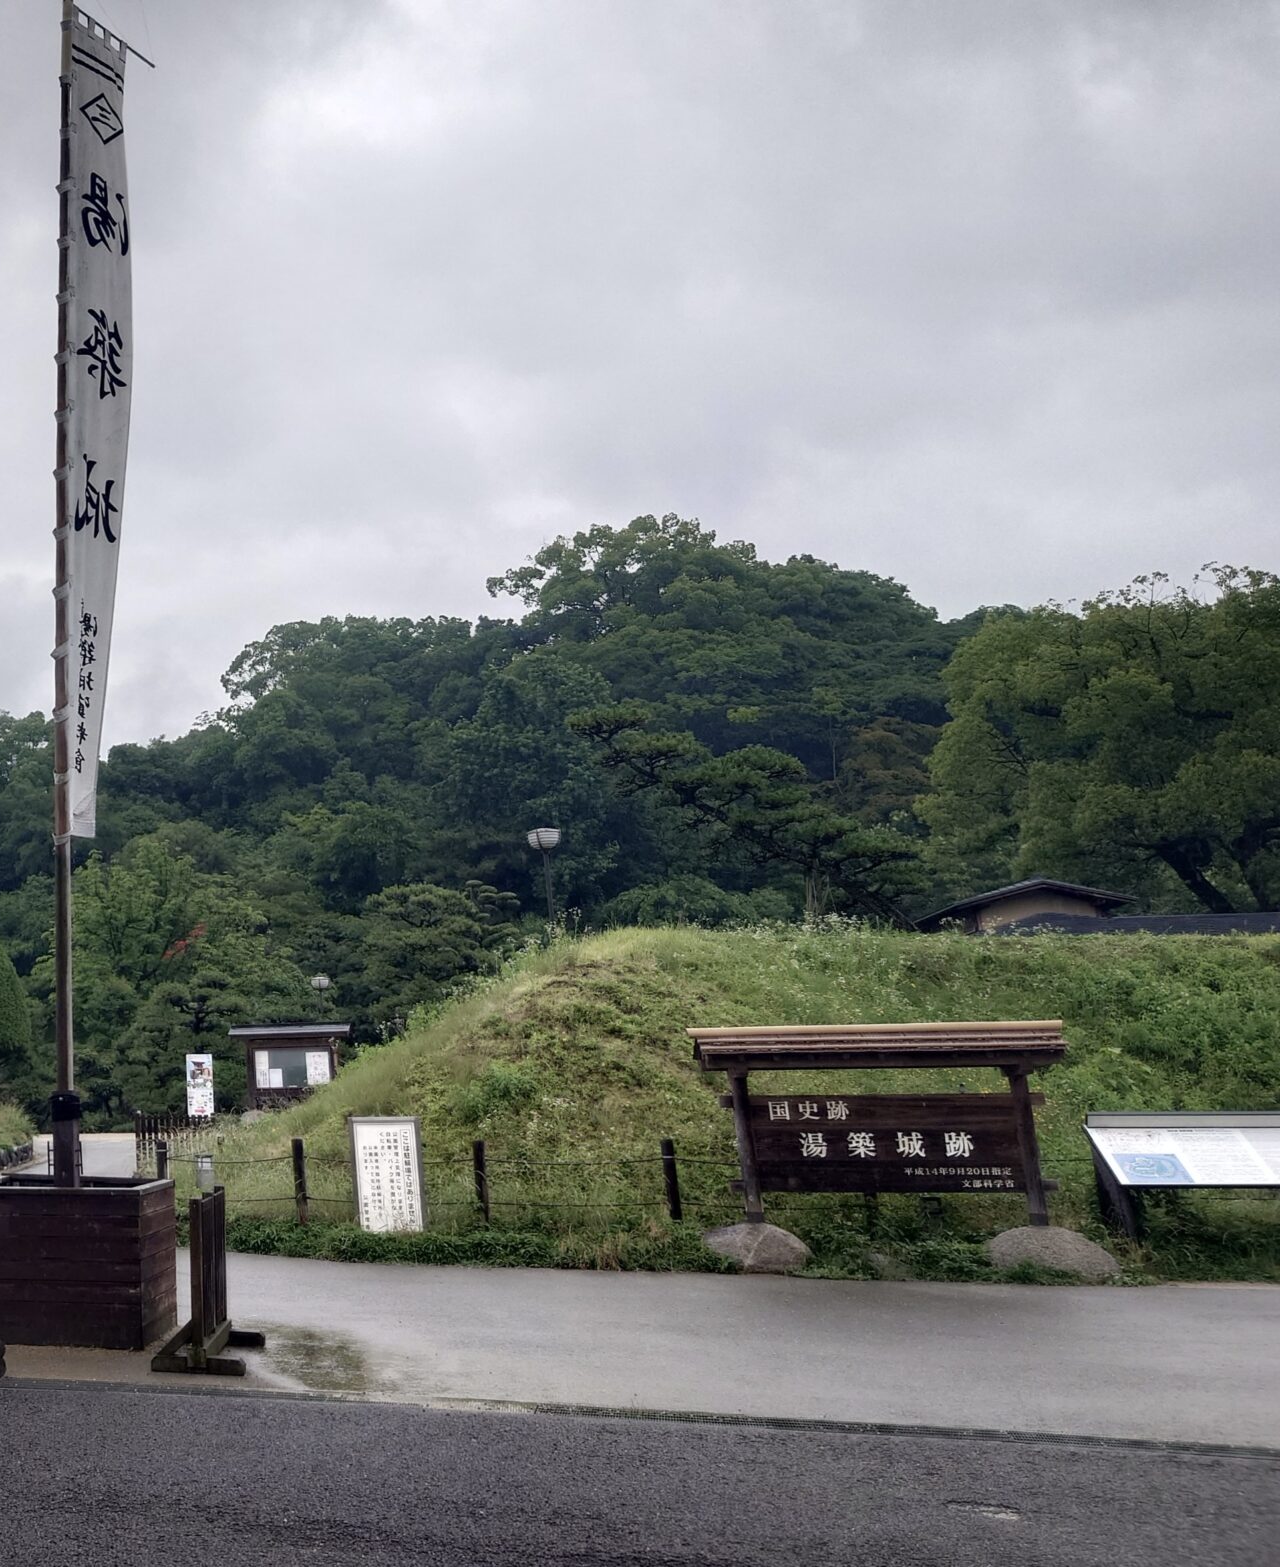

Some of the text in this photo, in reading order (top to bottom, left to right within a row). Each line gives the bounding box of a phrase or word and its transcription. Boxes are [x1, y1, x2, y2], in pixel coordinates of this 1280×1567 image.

[768, 1100, 850, 1121] 国史跡
[799, 1131, 974, 1159] 湯築城跡
[904, 1167, 1012, 1176] 平成14年9月20日指定
[962, 1180, 1015, 1188] 文部科学省
